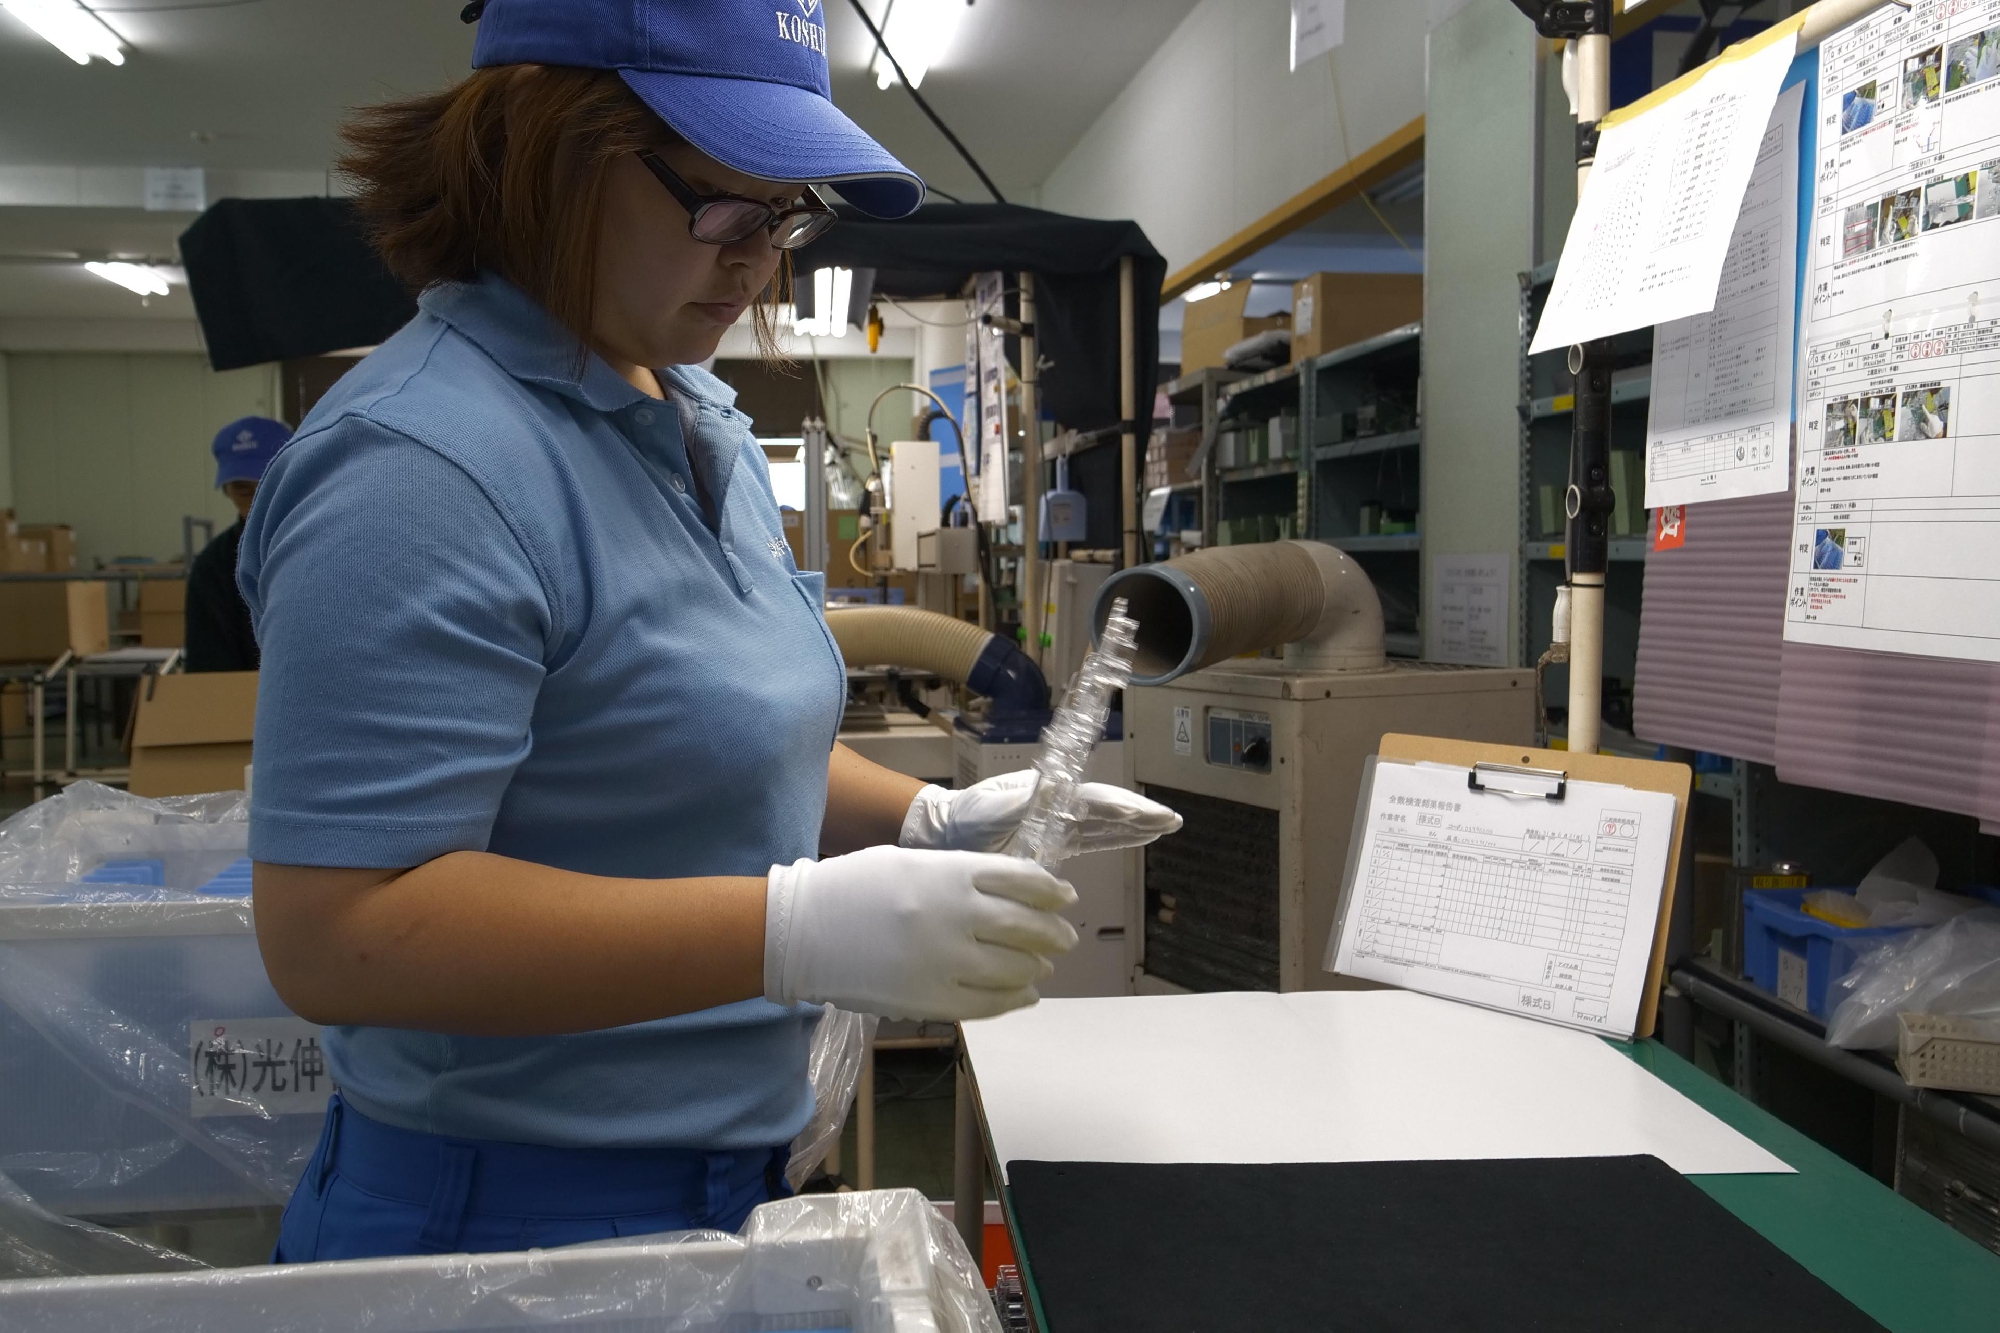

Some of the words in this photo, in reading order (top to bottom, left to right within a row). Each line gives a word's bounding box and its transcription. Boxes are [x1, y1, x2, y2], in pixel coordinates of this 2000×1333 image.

[1380, 812, 1407, 823] 作業者名
[1418, 814, 1441, 825] 様式B
[1520, 994, 1551, 1011] 様式B
[194, 1037, 336, 1097] (株)光伸
